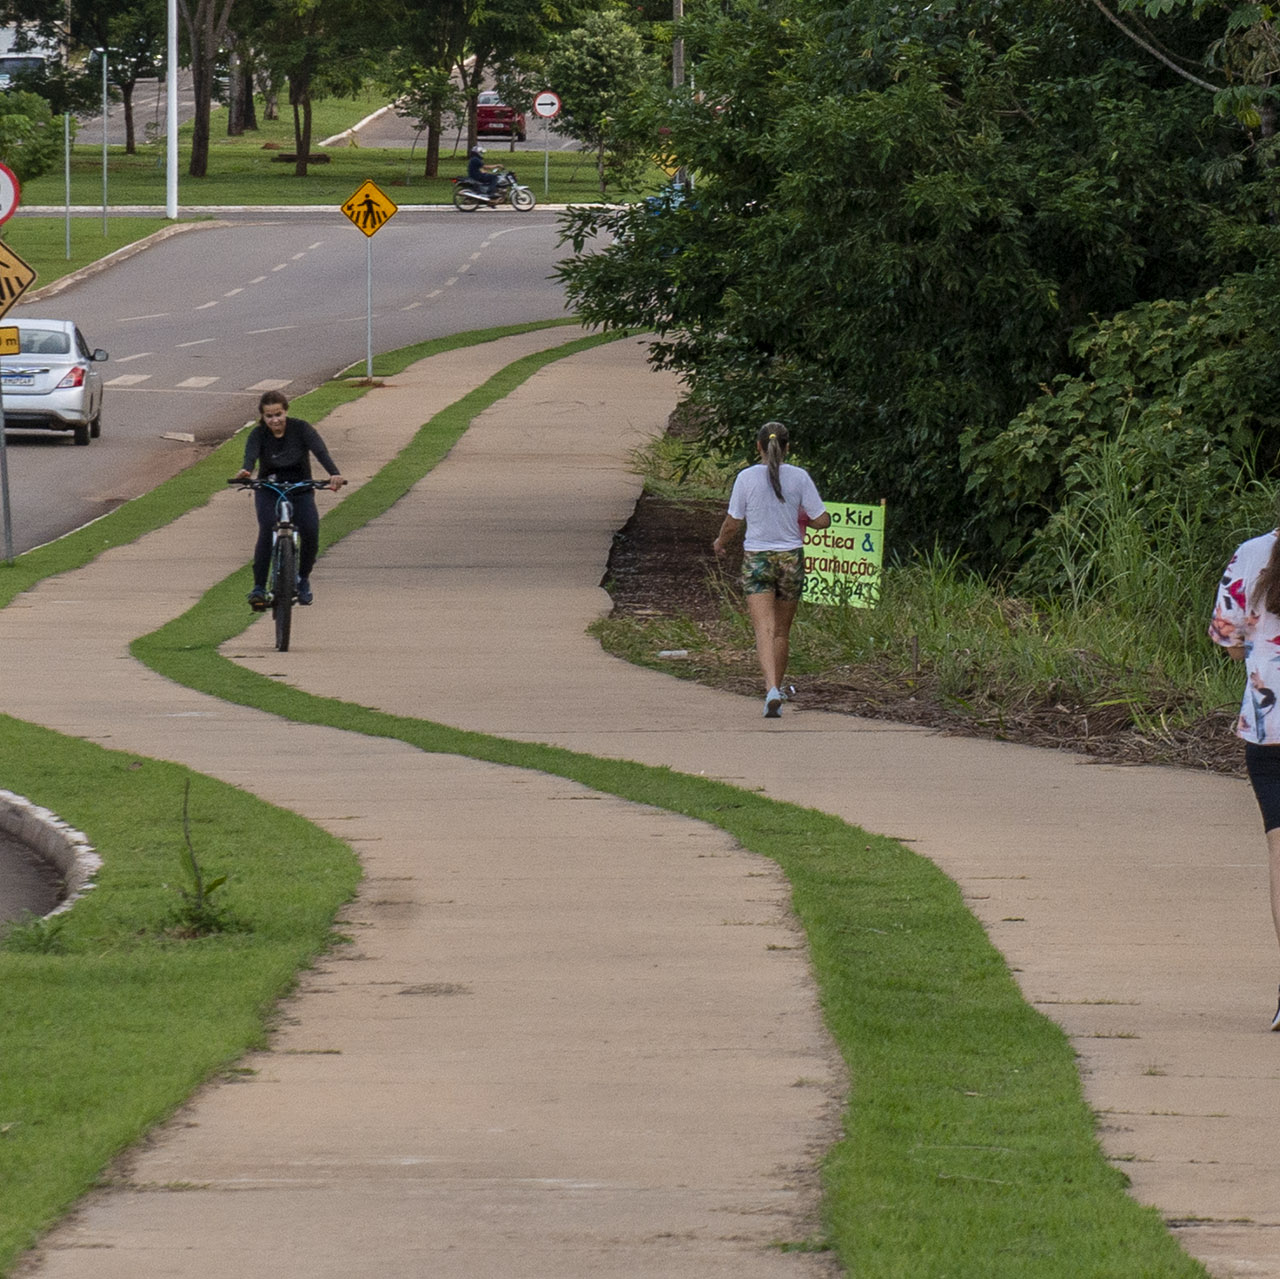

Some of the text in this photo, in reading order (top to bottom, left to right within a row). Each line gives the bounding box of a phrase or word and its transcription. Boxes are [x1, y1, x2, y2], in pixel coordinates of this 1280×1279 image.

[6, 338, 17, 346] m
[845, 507, 873, 526] Kid
[862, 533, 875, 552] &
